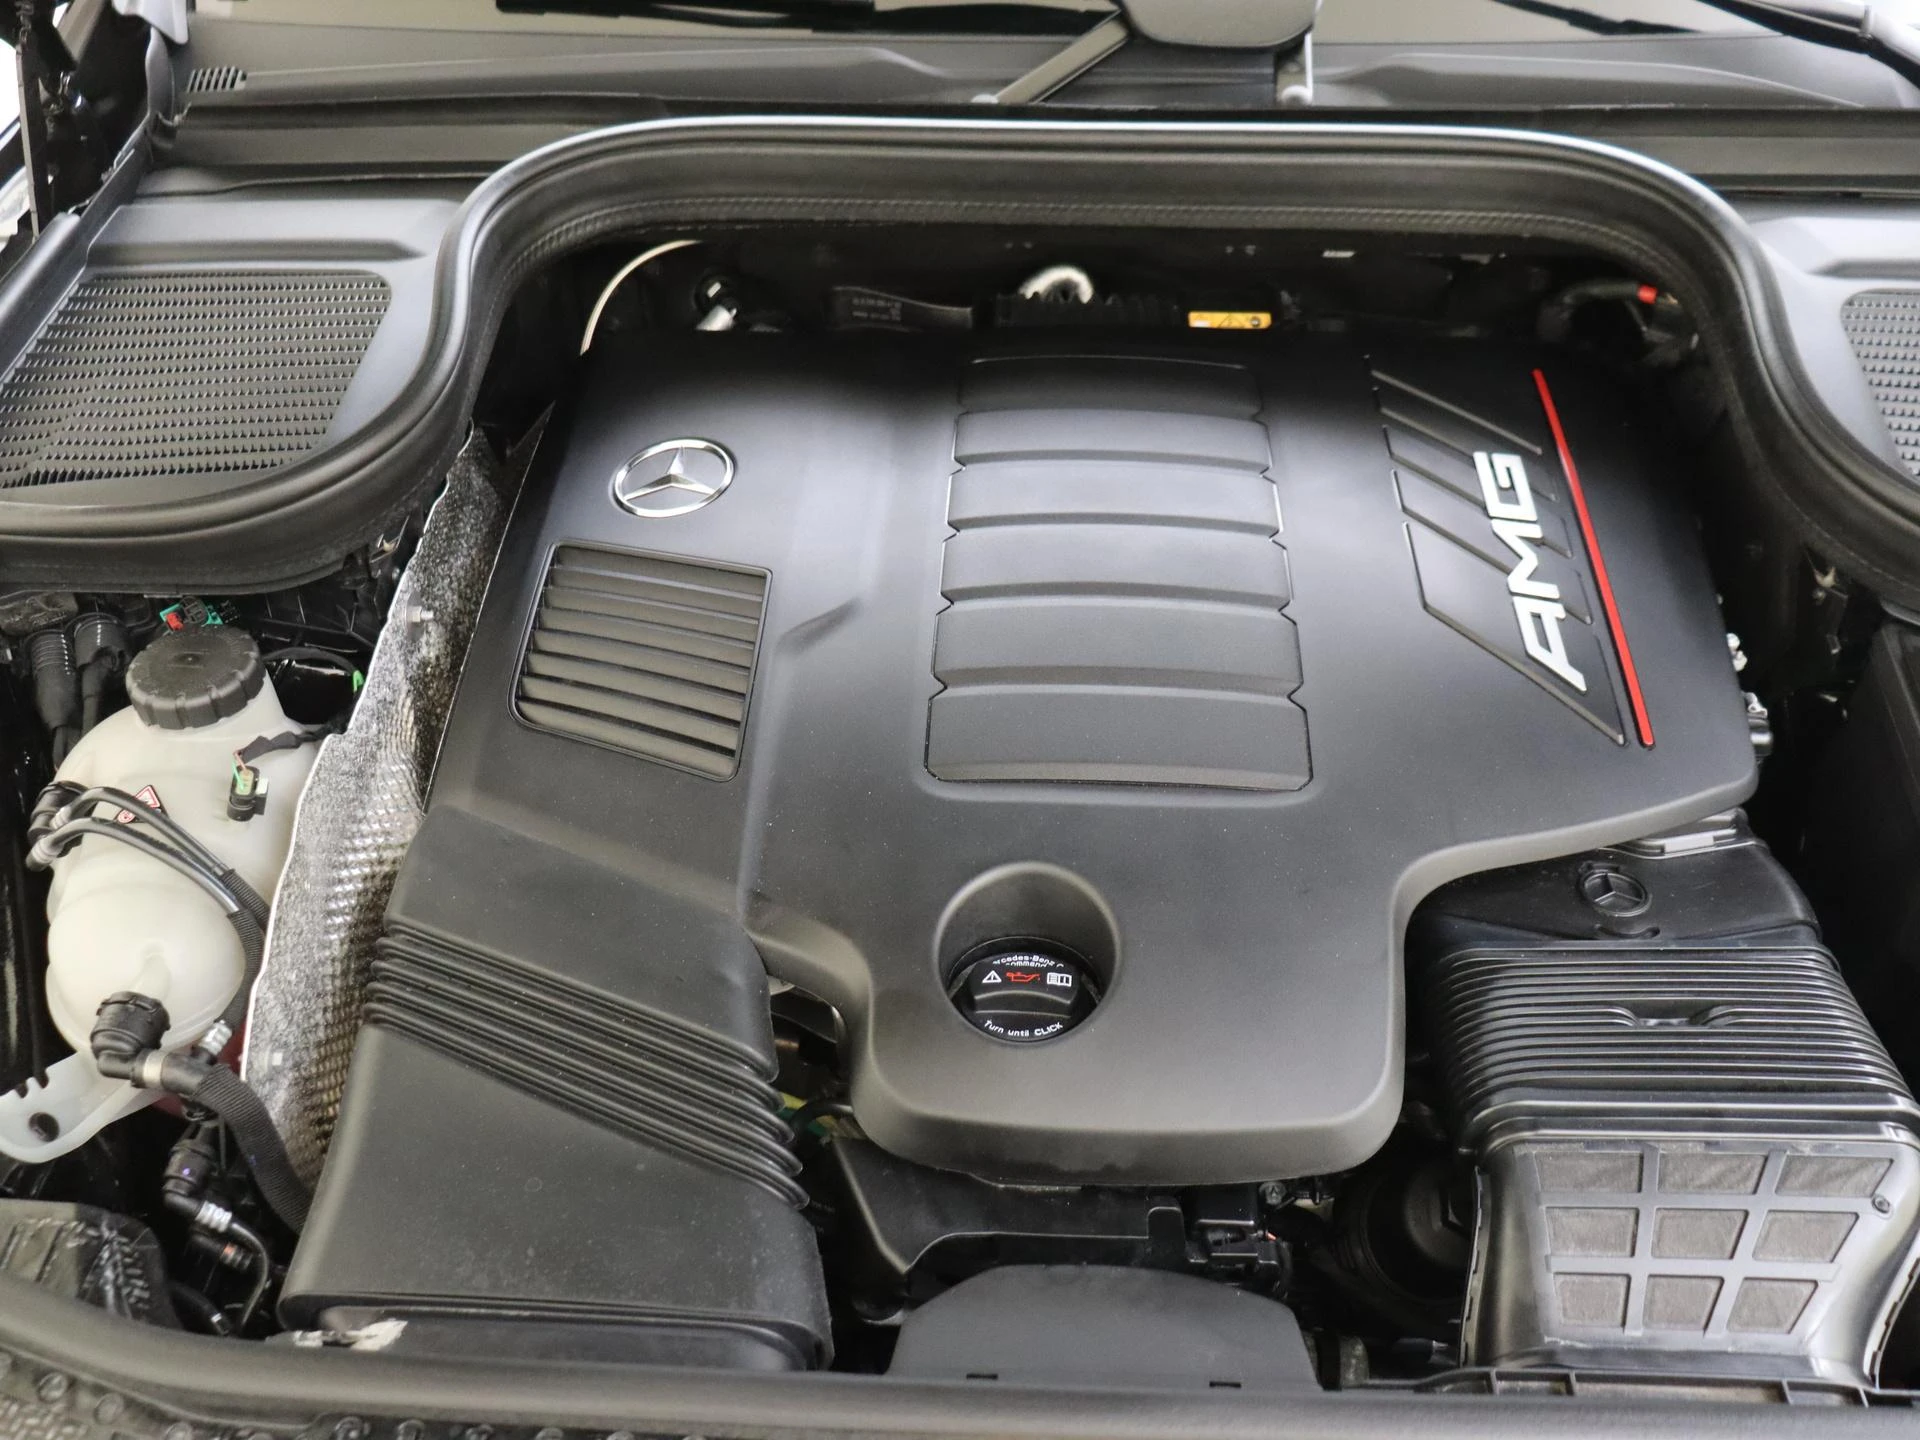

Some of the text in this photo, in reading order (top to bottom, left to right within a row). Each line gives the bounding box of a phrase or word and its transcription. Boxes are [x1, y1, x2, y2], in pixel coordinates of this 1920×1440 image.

[1473, 451, 1587, 692] AMG
[984, 1020, 1063, 1036] Turn until CLICK
